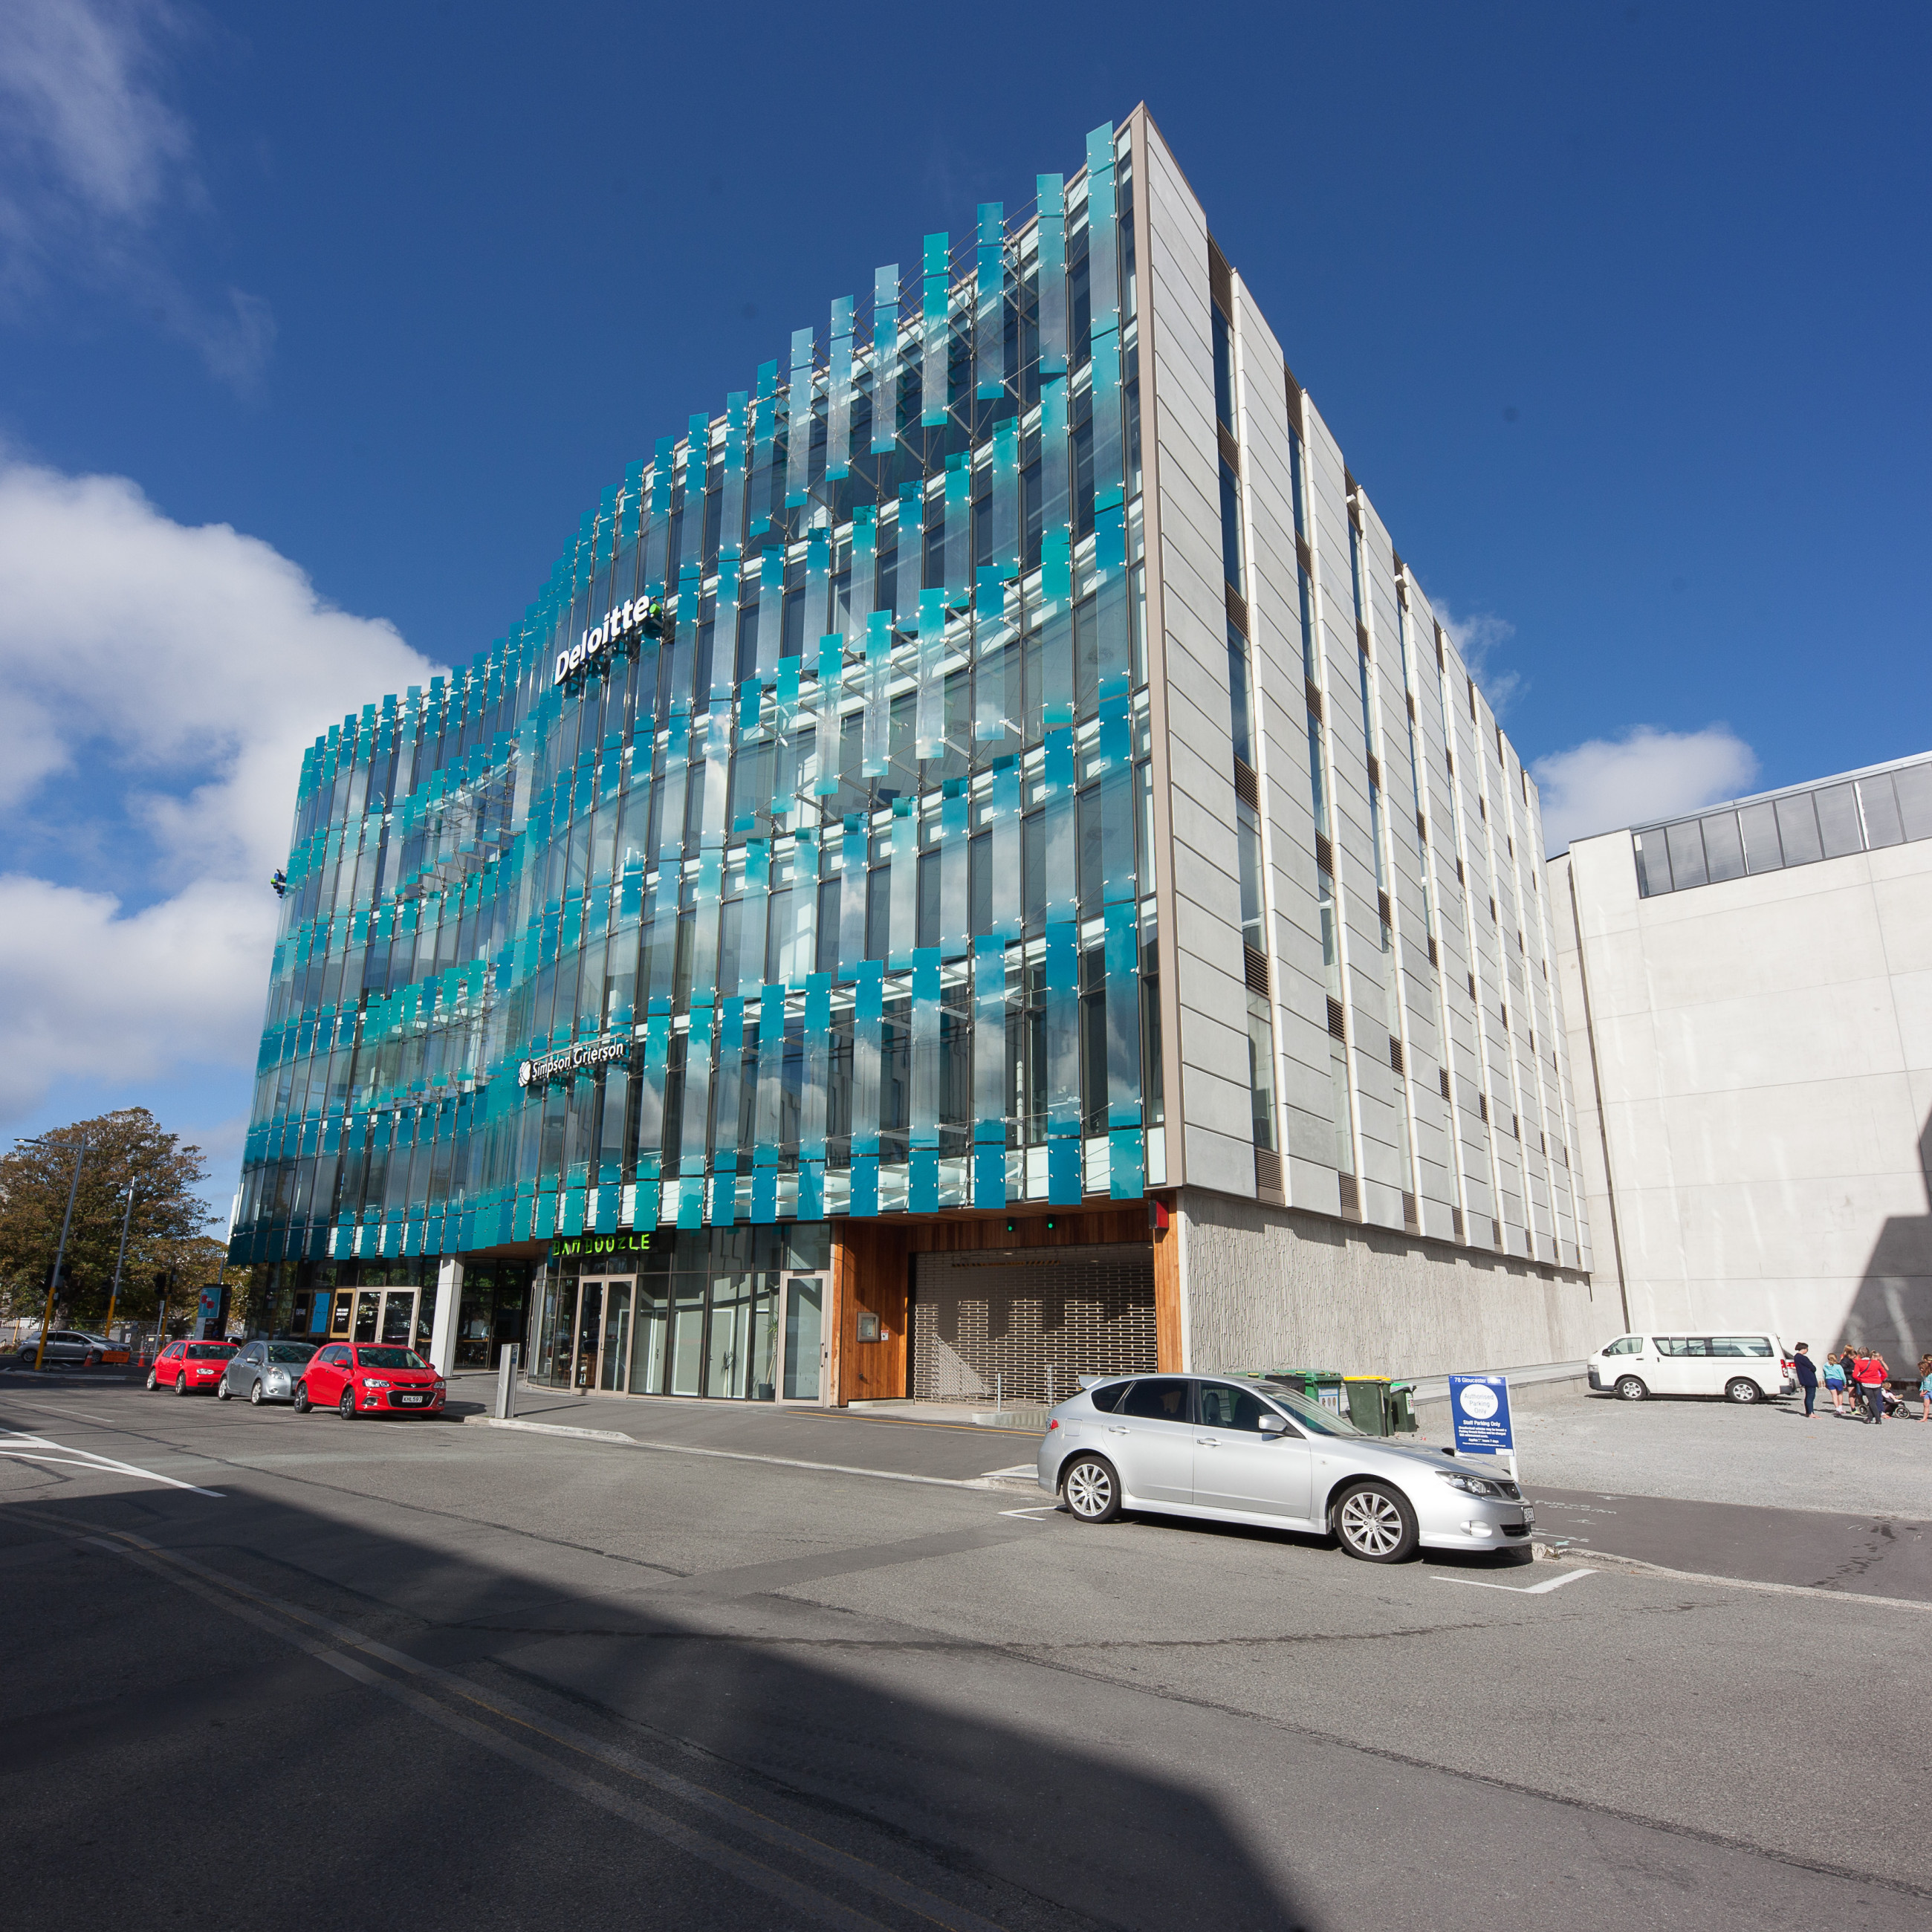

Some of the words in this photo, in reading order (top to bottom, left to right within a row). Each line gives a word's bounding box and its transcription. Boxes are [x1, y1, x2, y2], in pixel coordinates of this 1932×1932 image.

[532, 1056, 571, 1078] Simpson
[574, 1043, 624, 1064] Grierson
[552, 1234, 650, 1256] BAMBOOZLE
